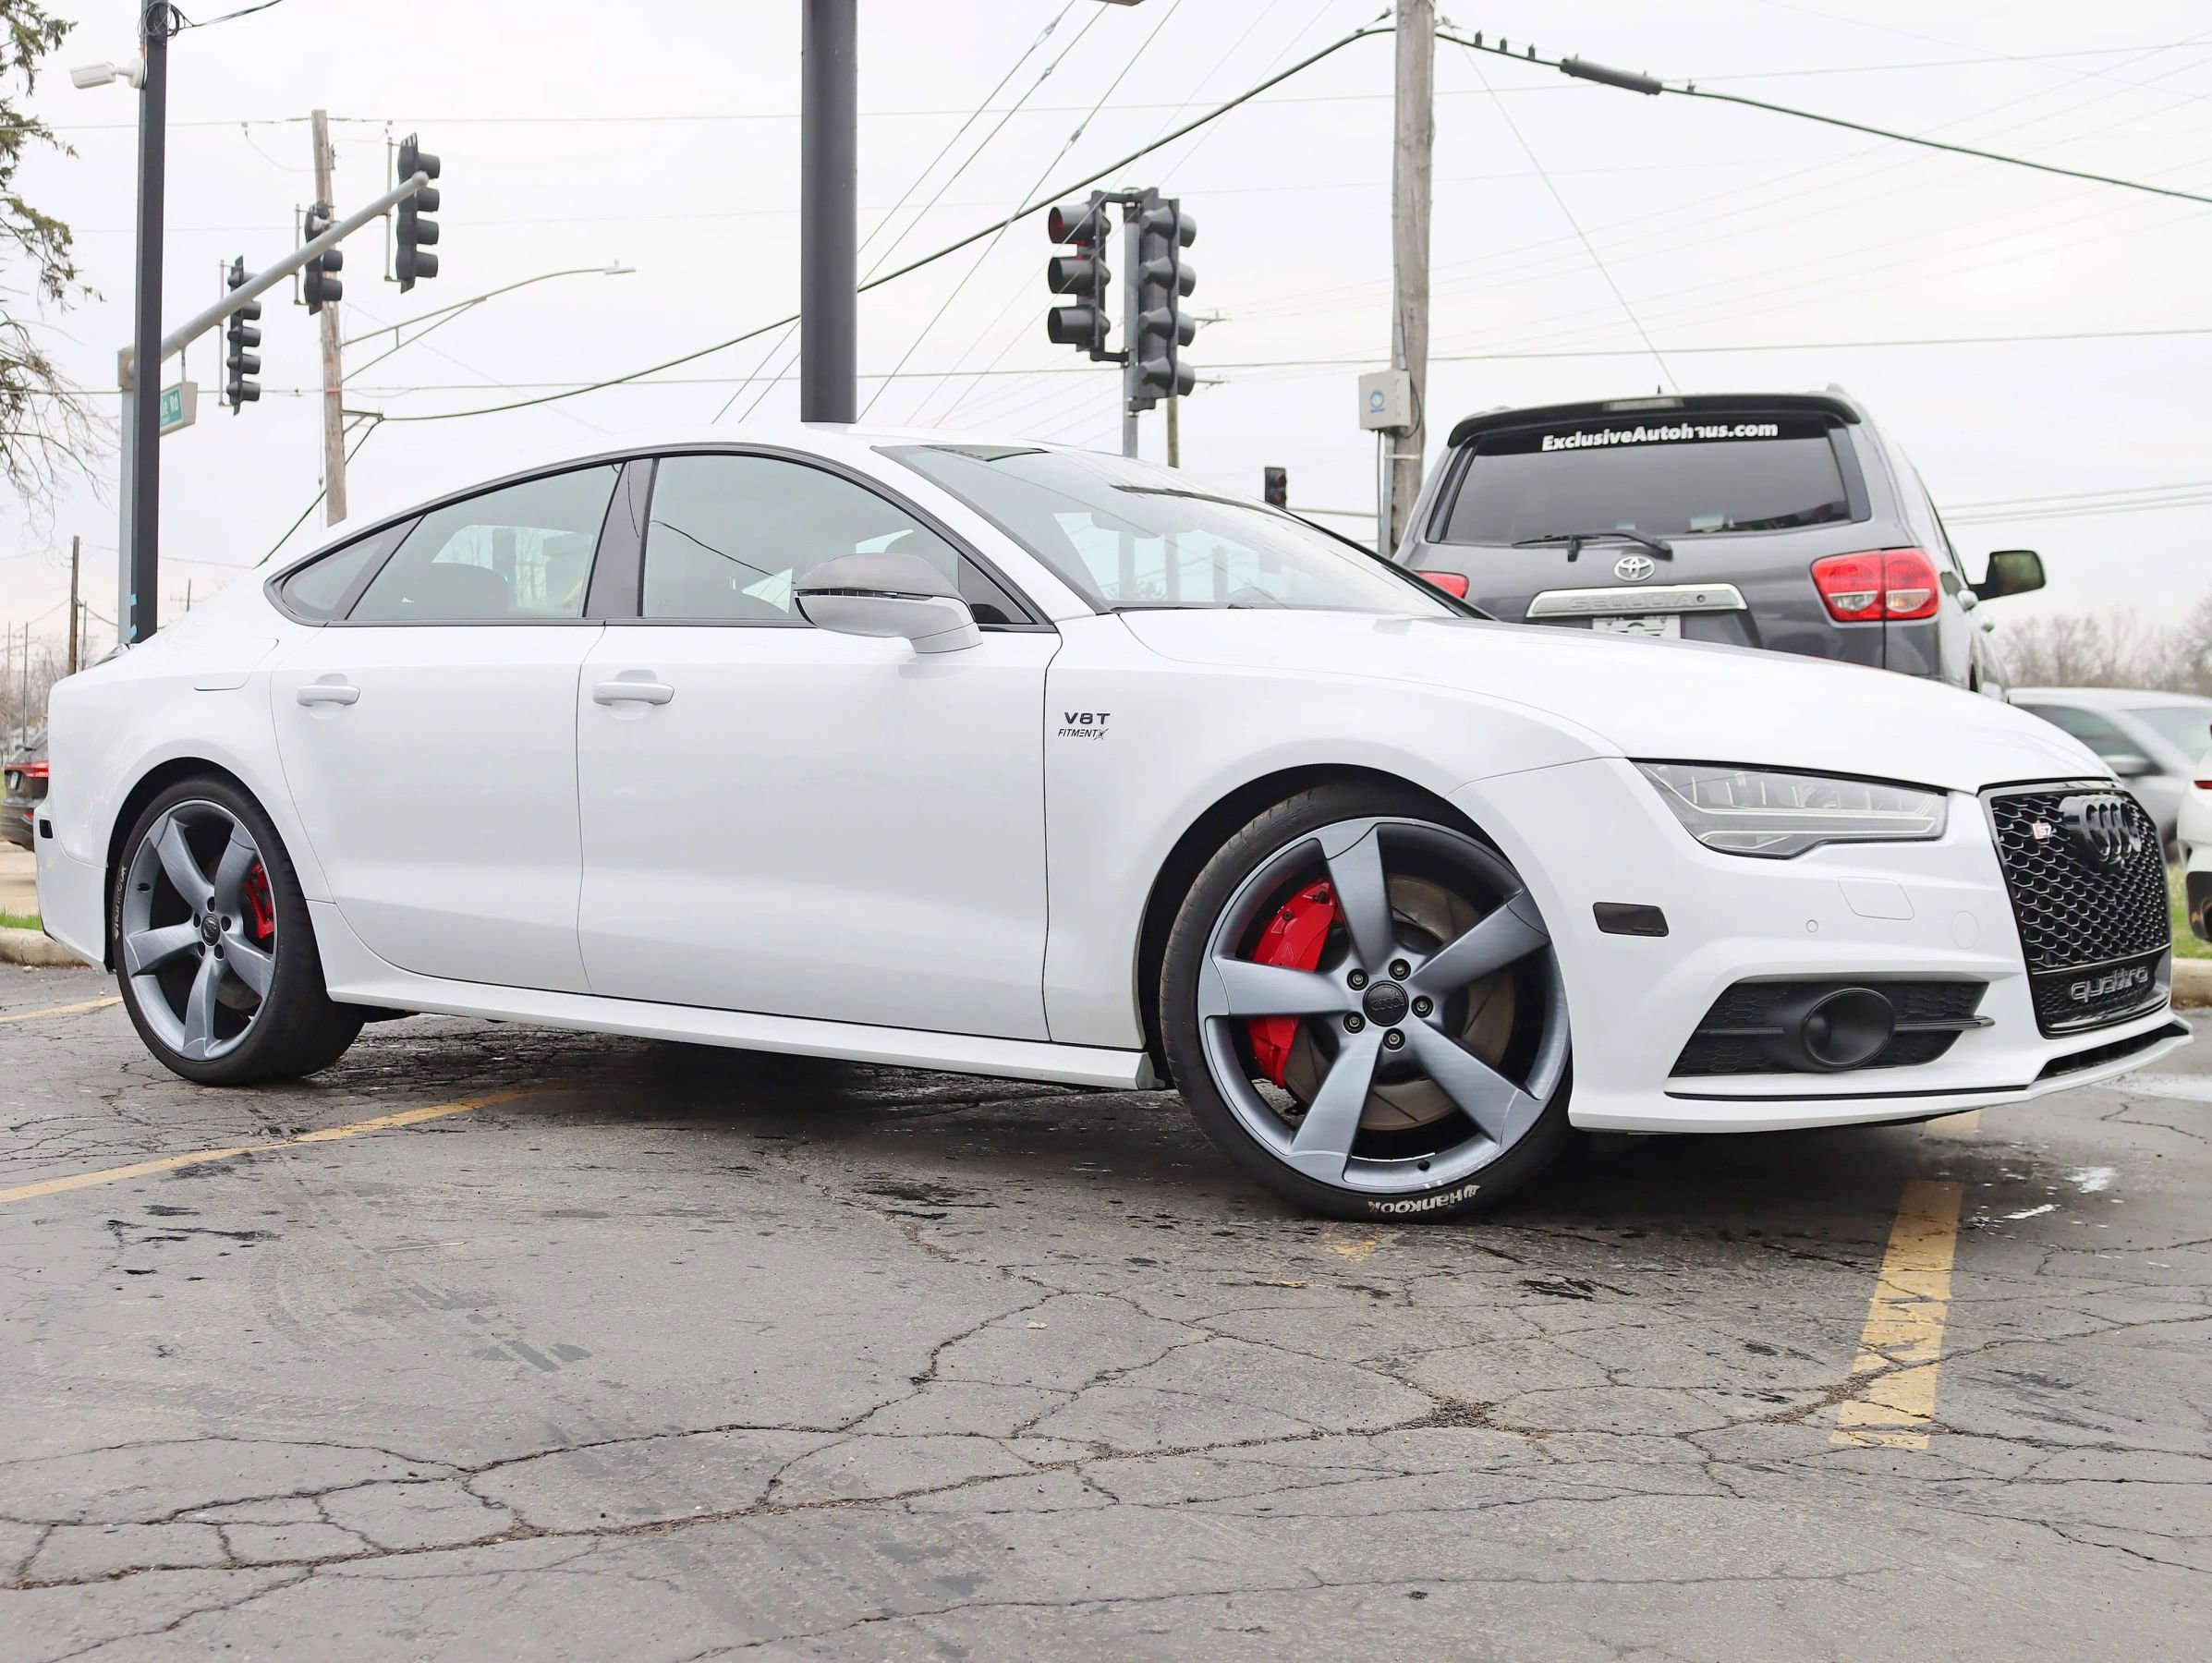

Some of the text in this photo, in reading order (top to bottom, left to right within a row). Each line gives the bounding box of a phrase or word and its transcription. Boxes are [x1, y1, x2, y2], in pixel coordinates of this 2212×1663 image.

[1570, 593, 1696, 611] SEQUOIA
[1064, 711, 1111, 725] V8T
[2071, 966, 2148, 1002] quattro
